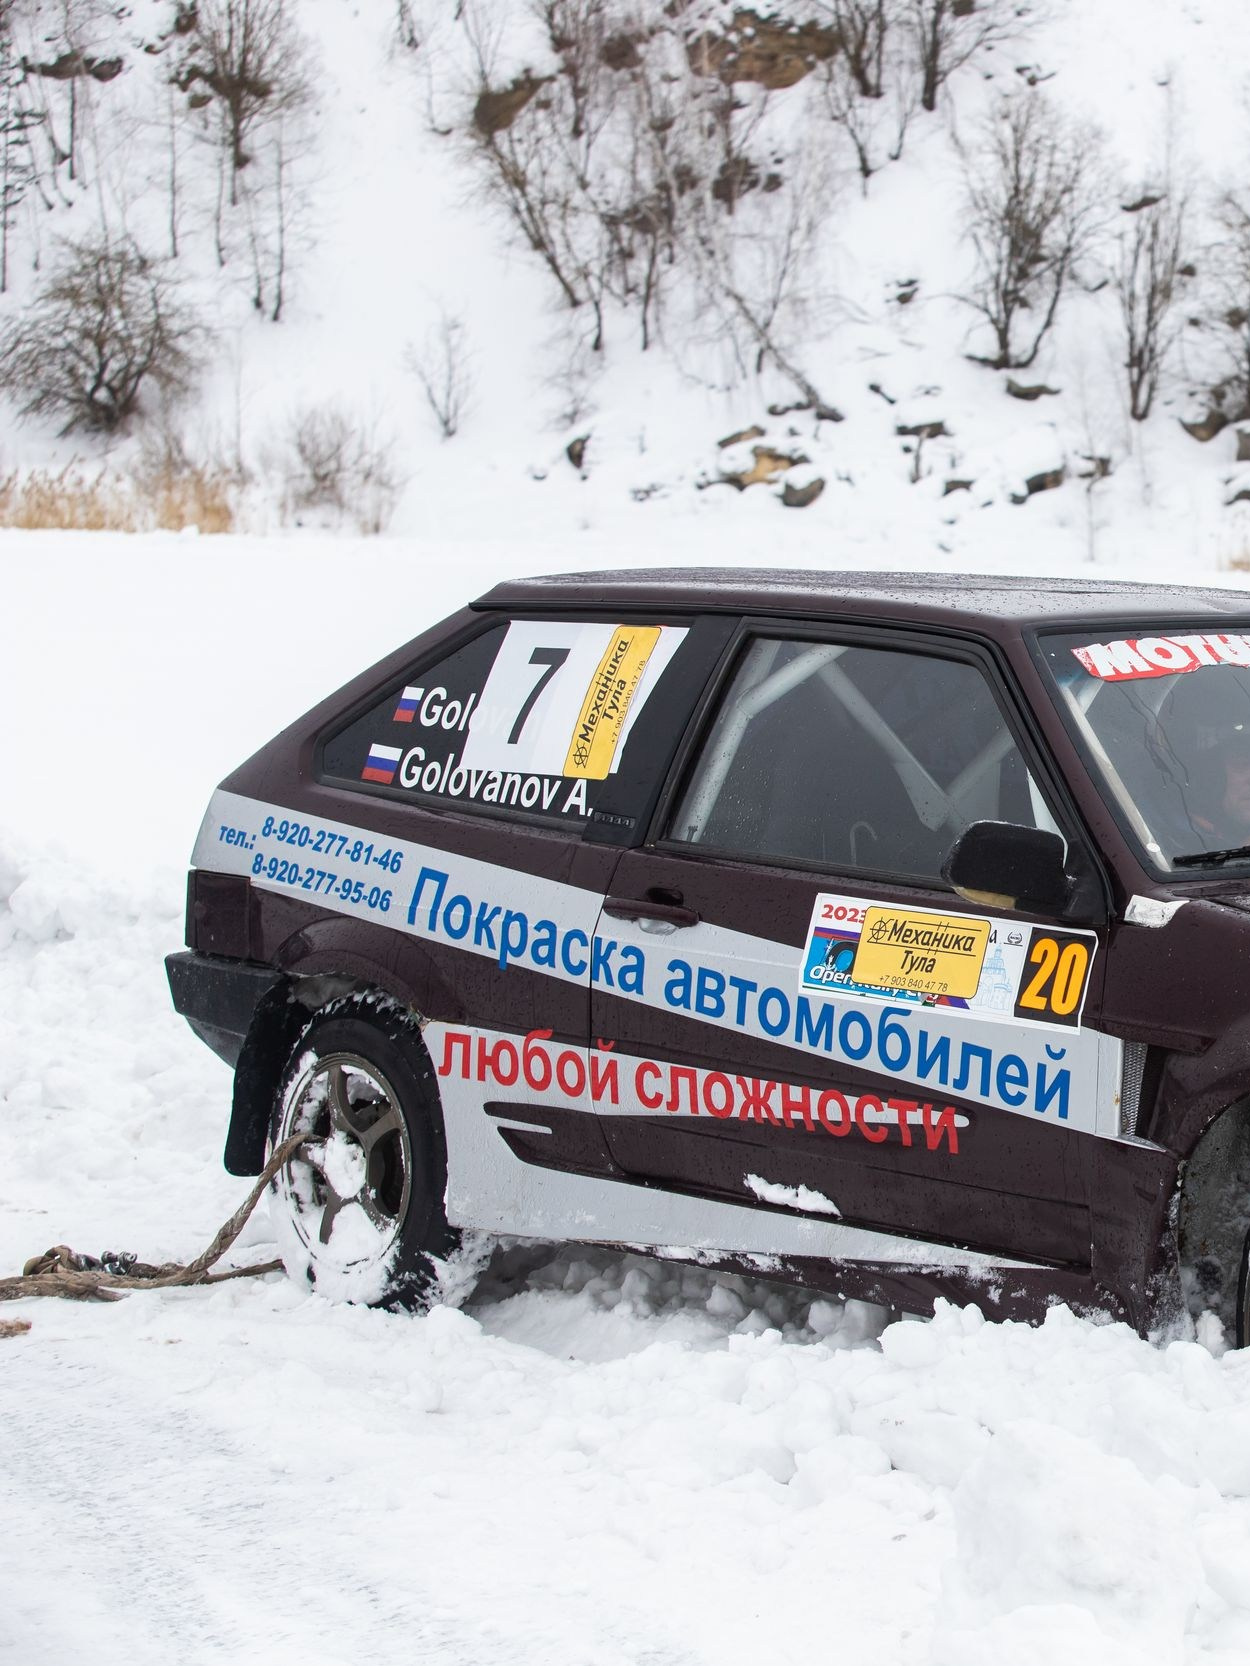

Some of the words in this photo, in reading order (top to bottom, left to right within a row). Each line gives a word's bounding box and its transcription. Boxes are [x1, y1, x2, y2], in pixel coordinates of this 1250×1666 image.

[506, 647, 571, 745] 7
[578, 640, 629, 743] Механика
[602, 679, 627, 721] Тула
[400, 746, 561, 810] Golovanov
[219, 825, 257, 850] тел.:
[261, 816, 404, 873] 8-920-277-81-46
[252, 853, 393, 912] 8-920-277-95-06
[888, 919, 976, 952] Механика
[900, 950, 937, 975] Тула
[407, 867, 645, 997] Покраска
[663, 959, 1072, 1120] автомобилей
[879, 975, 890, 983] +7
[891, 976, 906, 987] 903
[907, 979, 923, 989] 840
[924, 981, 936, 990] 47
[938, 982, 949, 992] 78
[1019, 937, 1089, 1016] 20
[438, 1028, 619, 1105] любой
[634, 1061, 959, 1154] сложности
